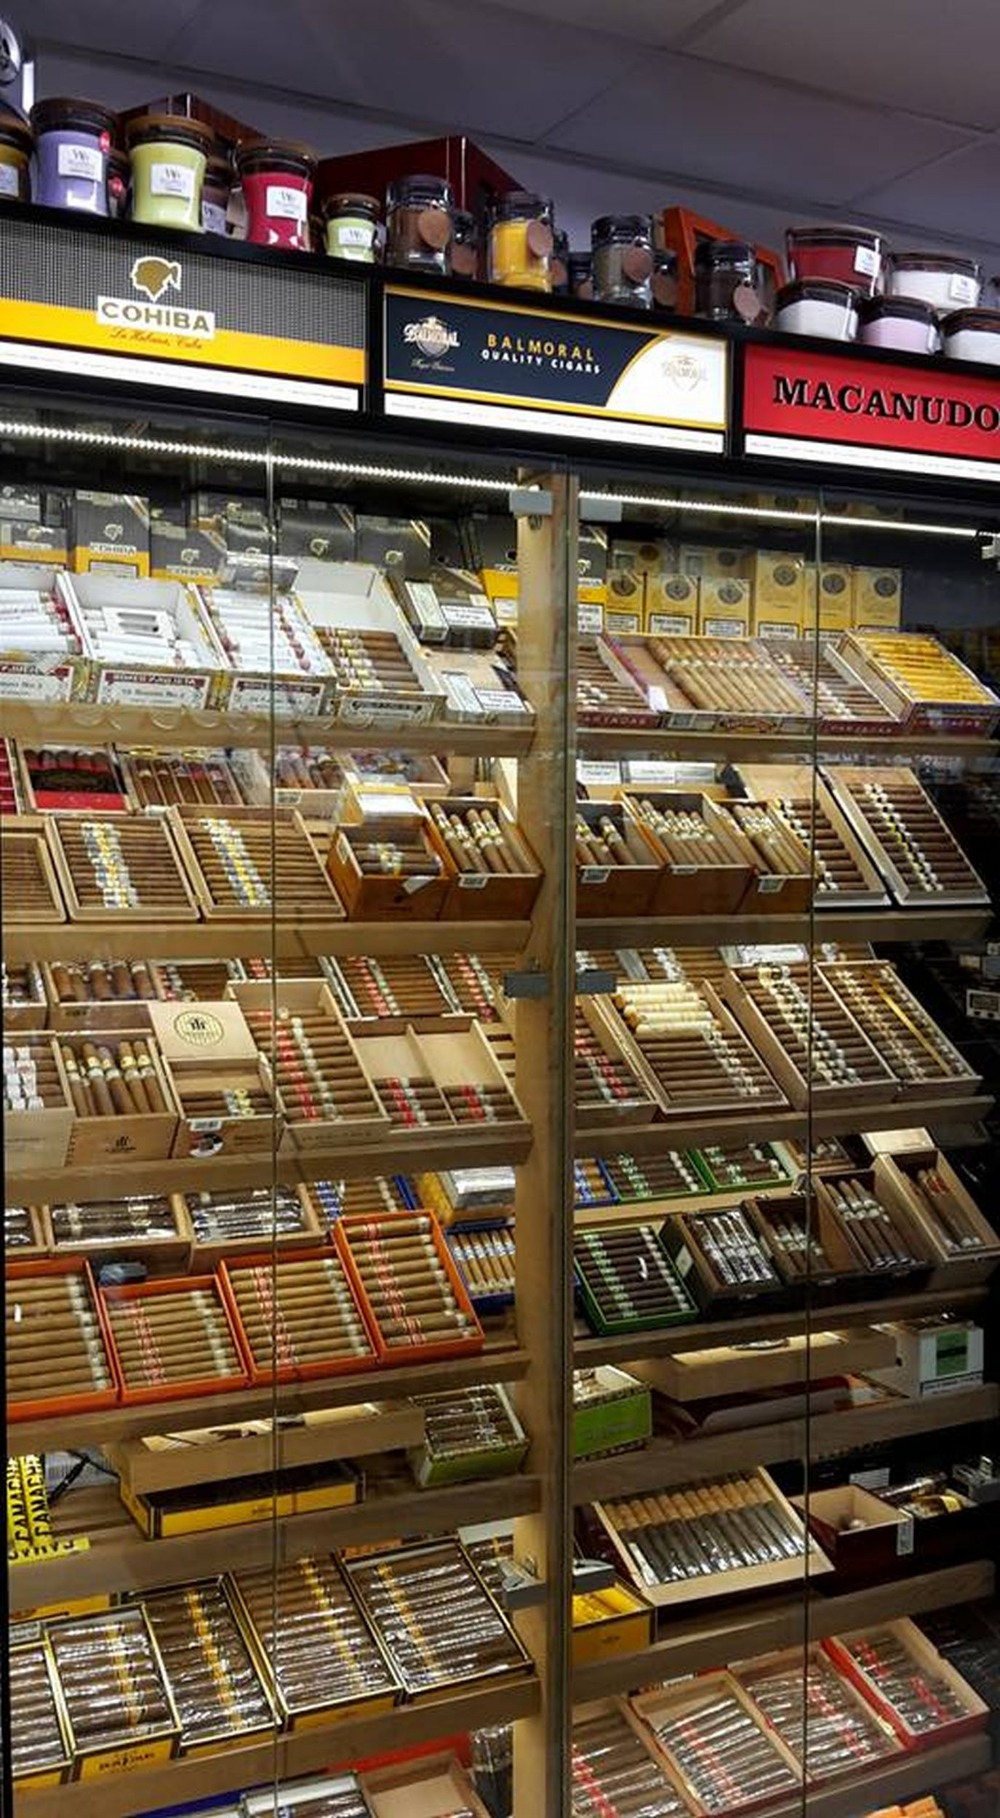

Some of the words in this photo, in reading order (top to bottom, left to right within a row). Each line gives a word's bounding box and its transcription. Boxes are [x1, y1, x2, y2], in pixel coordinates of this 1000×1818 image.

[101, 302, 210, 332] COHIBA
[487, 334, 594, 362] BALMORAL
[481, 350, 543, 366] QUALITY
[551, 359, 601, 375] CIGARS
[772, 375, 1000, 432] MACANUDO
[90, 543, 137, 556] COHIBA
